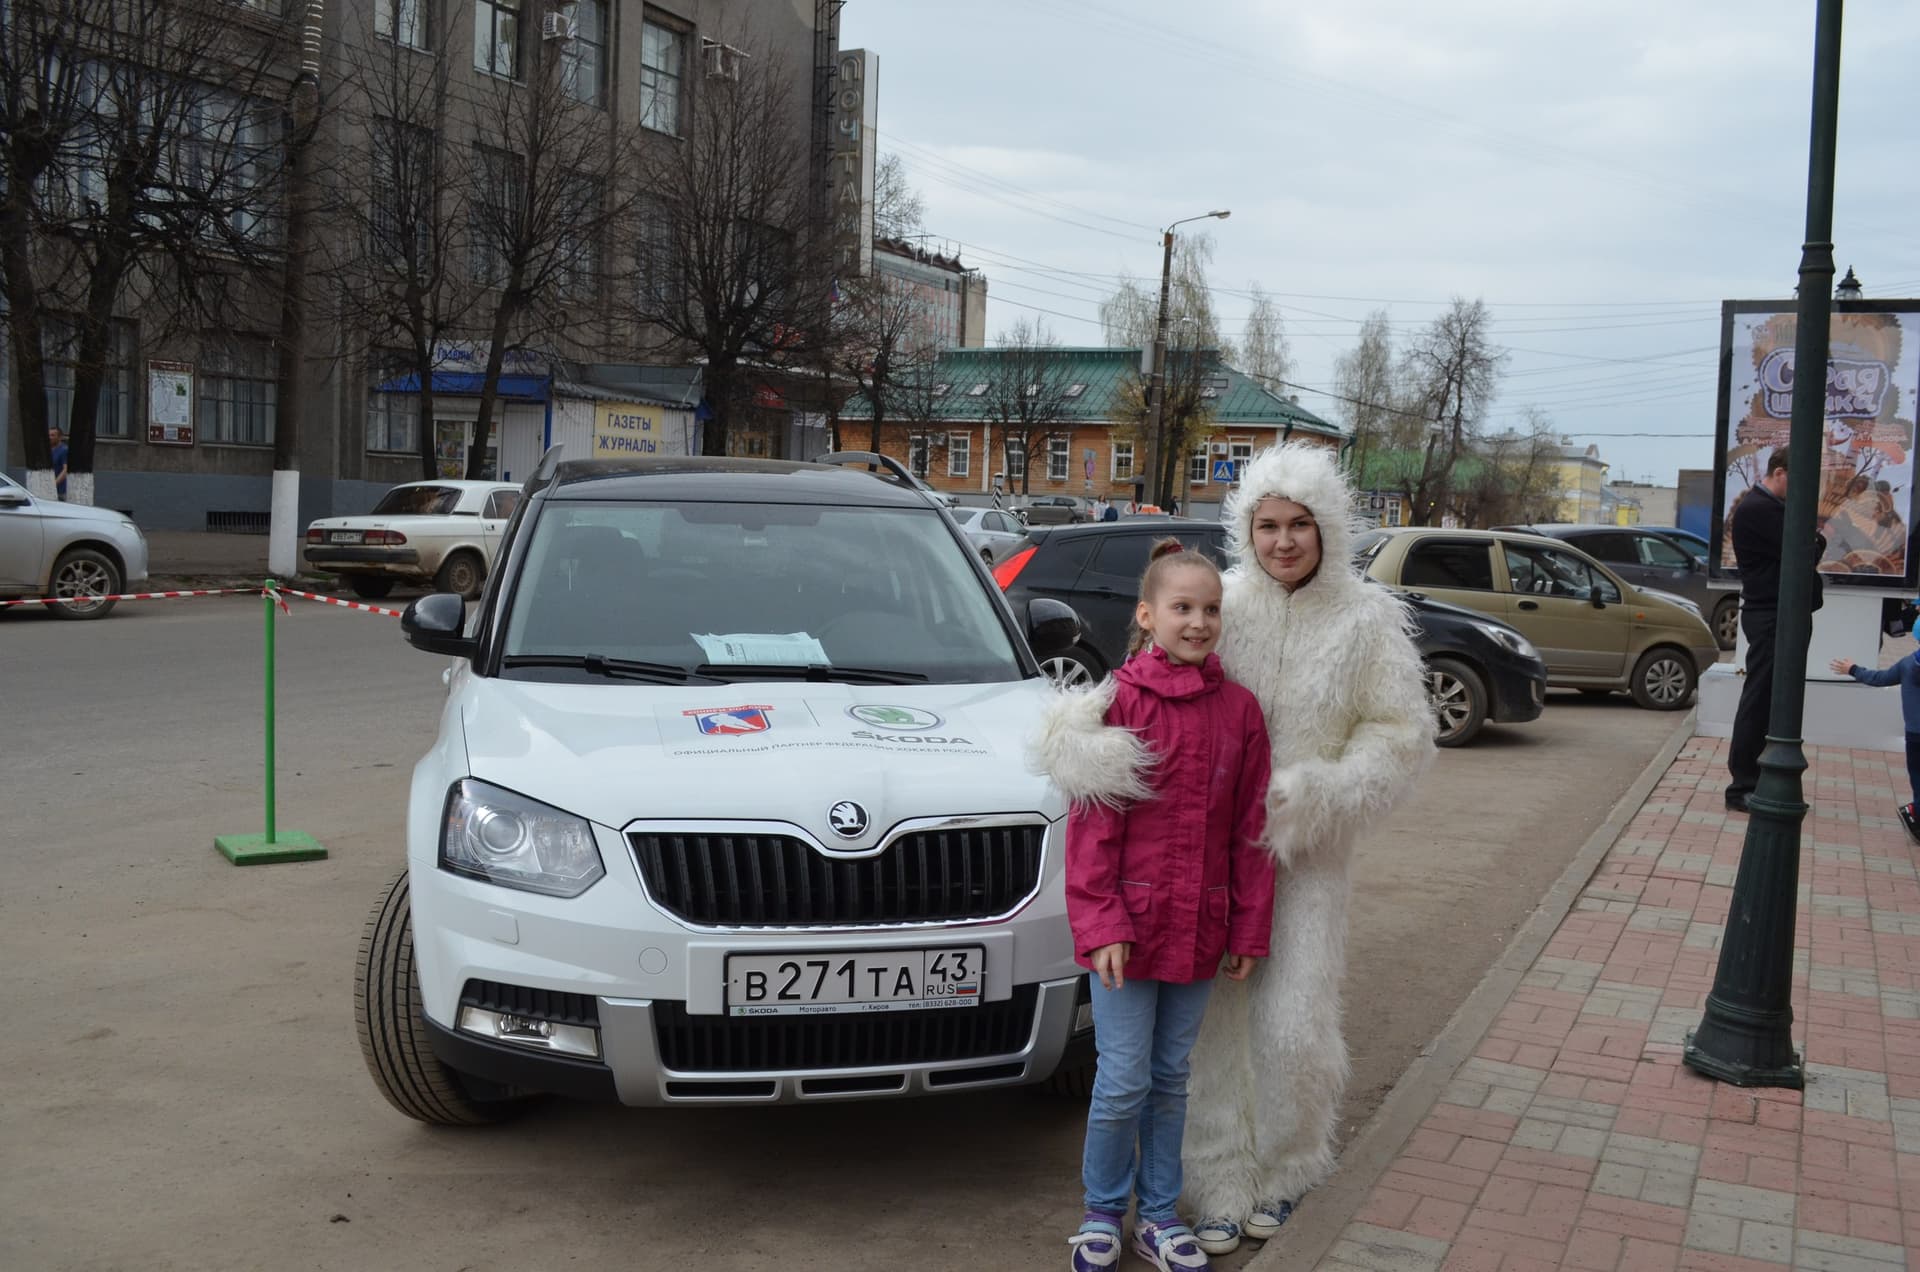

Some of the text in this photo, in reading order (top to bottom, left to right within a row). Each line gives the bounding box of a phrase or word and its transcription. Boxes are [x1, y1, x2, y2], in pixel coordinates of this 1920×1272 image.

[608, 413, 652, 431] ГАЗЕТЫ
[599, 435, 656, 453] ЖУРНАЛЫ
[851, 730, 974, 745] ŠKODA
[673, 746, 769, 756] ОФИЦИАЛЬНЫЙ
[745, 952, 968, 1001] В271ТА 43
[926, 983, 955, 995] RUS
